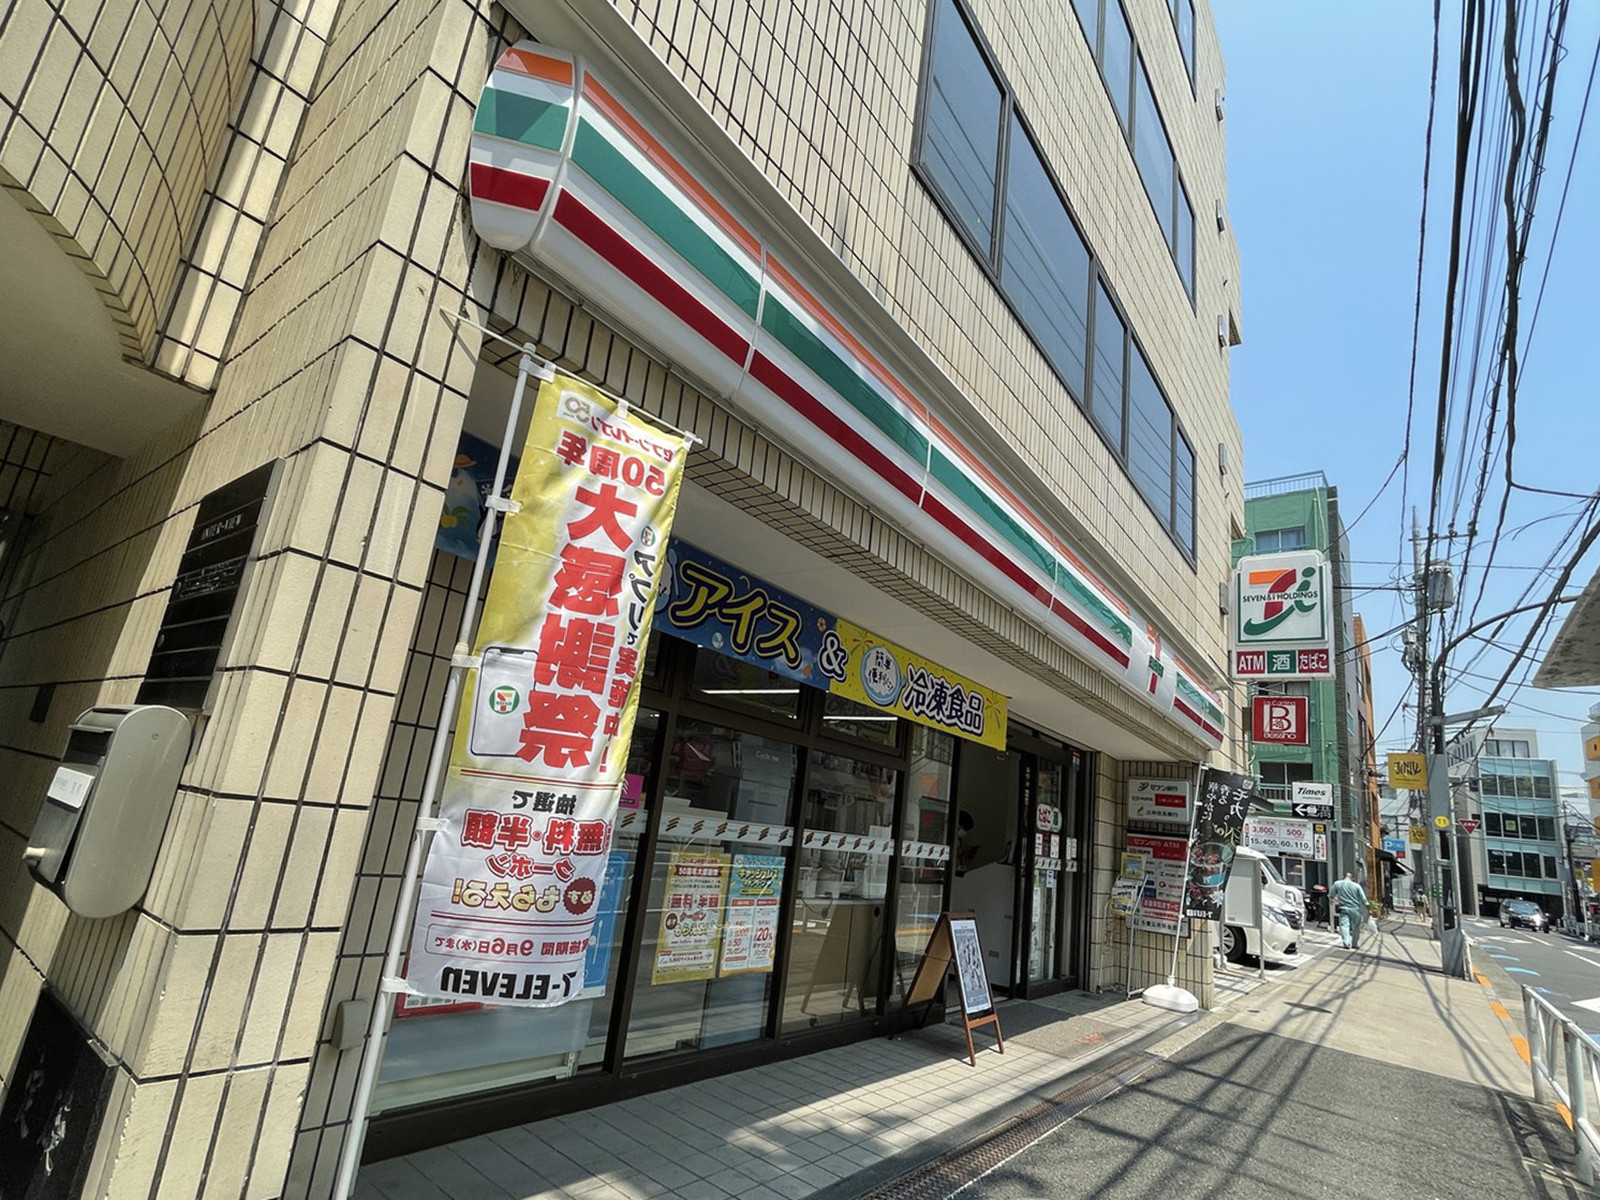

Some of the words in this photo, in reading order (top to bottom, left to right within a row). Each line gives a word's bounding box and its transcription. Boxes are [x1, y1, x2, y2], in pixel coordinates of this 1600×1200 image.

[1277, 591, 1319, 600] HOLDINGS
[671, 562, 803, 669] アイス
[817, 631, 848, 682] &
[903, 663, 984, 737] 冷凍食品
[1238, 655, 1264, 671] ATM
[1272, 654, 1290, 671] 酒
[1299, 653, 1328, 669] たばこ
[1269, 705, 1292, 731] B
[1297, 787, 1327, 796] Times
